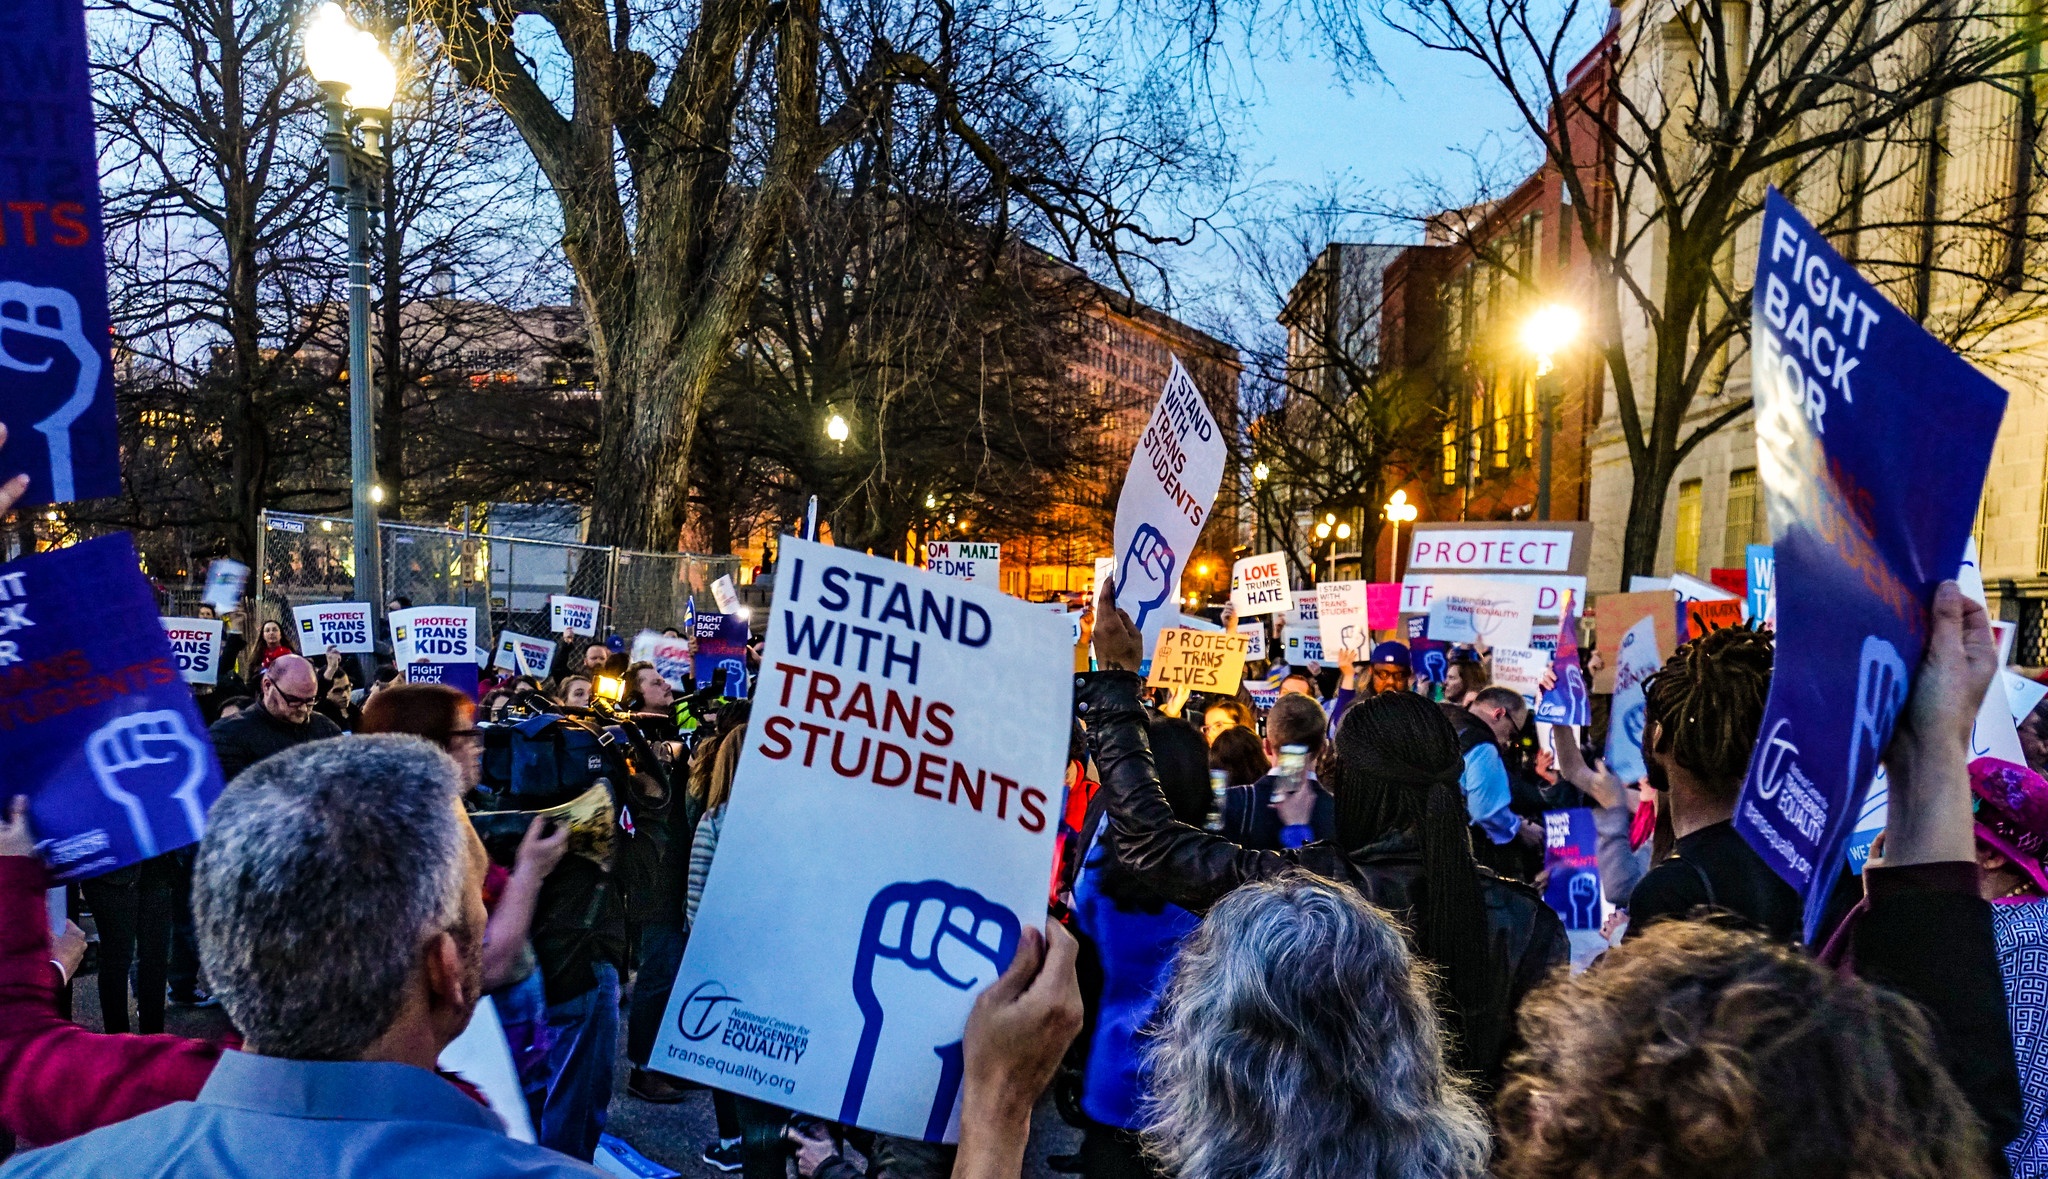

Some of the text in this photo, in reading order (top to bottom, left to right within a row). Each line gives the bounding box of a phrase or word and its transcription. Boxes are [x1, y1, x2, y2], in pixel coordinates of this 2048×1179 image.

[1771, 217, 1880, 350] FIGHT
[1764, 272, 1860, 404] BACK
[1761, 327, 1827, 434] FOR
[1173, 364, 1212, 442] I STAND
[1164, 383, 1190, 441] WITH
[1155, 405, 1187, 474] TRANS
[1144, 428, 1204, 527] STUDENTS
[927, 543, 998, 560] OM MANI
[1414, 542, 1559, 565] PROTECT
[1244, 563, 1279, 581] LOVE
[1245, 579, 1281, 591] TRUMPS
[1323, 584, 1351, 592] STAND
[790, 558, 803, 602] I
[818, 566, 992, 648] STAND
[1247, 588, 1284, 606] HATE
[319, 612, 365, 621] PROTECT
[564, 603, 594, 613] PROTECT
[564, 610, 593, 620] TRANS
[1320, 607, 1361, 616] STUDENT
[1446, 604, 1475, 614] TRANS
[319, 621, 366, 632] TRANS
[414, 618, 468, 628] PROTECT
[563, 617, 592, 629] KIDS
[697, 614, 723, 623] FIGHT
[697, 622, 721, 631] BACK
[322, 631, 367, 645] KIDS
[414, 628, 468, 640] TRANS
[696, 630, 714, 638] FOR
[1165, 630, 1250, 653] PROTECT
[414, 640, 468, 656] KIDS
[784, 610, 921, 685] WITH
[1181, 651, 1225, 668] TRANS
[411, 665, 444, 675] FIGHT
[1158, 666, 1218, 686] LIVES
[411, 674, 442, 684] BACK
[775, 662, 955, 747] TRANS
[758, 715, 1048, 835] STUDENTS
[730, 1007, 770, 1025] National
[768, 1016, 797, 1034] Center
[727, 1016, 809, 1050] TRANSGENDER
[721, 1028, 806, 1066] EQUALITY
[667, 1043, 797, 1095] transequality.org
